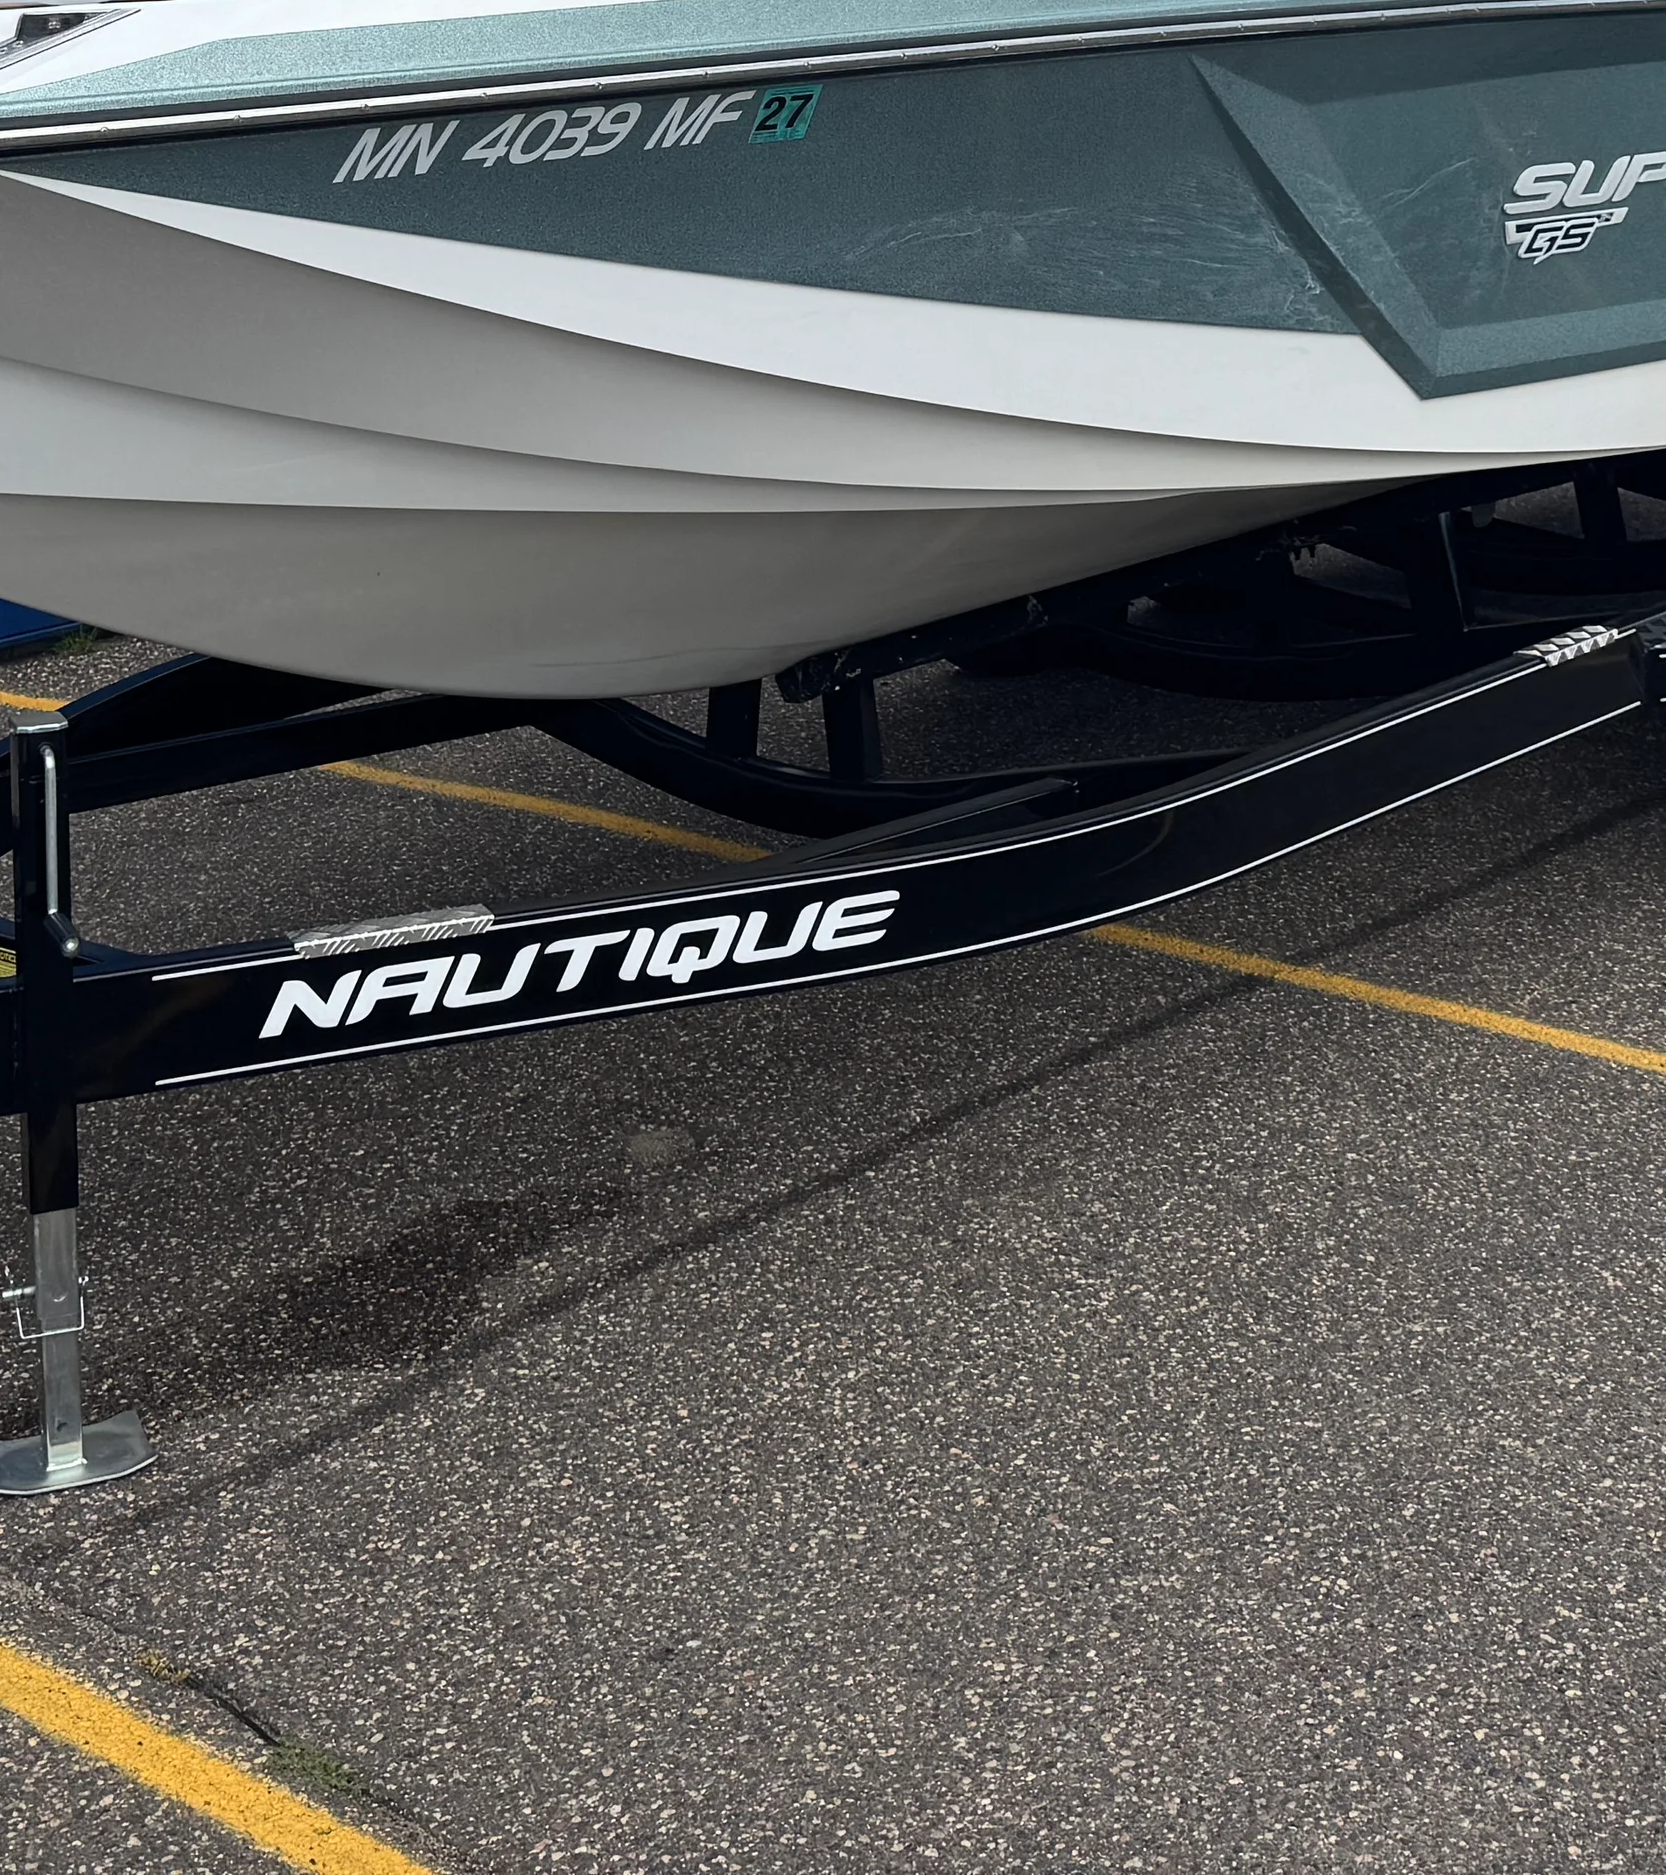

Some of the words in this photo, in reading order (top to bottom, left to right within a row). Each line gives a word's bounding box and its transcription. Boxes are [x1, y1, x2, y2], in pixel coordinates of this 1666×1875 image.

[333, 119, 460, 185] MN
[461, 103, 643, 168] 4039
[643, 89, 757, 151] MF
[754, 93, 815, 132] 27
[259, 890, 900, 1039] NAUTIQUE
